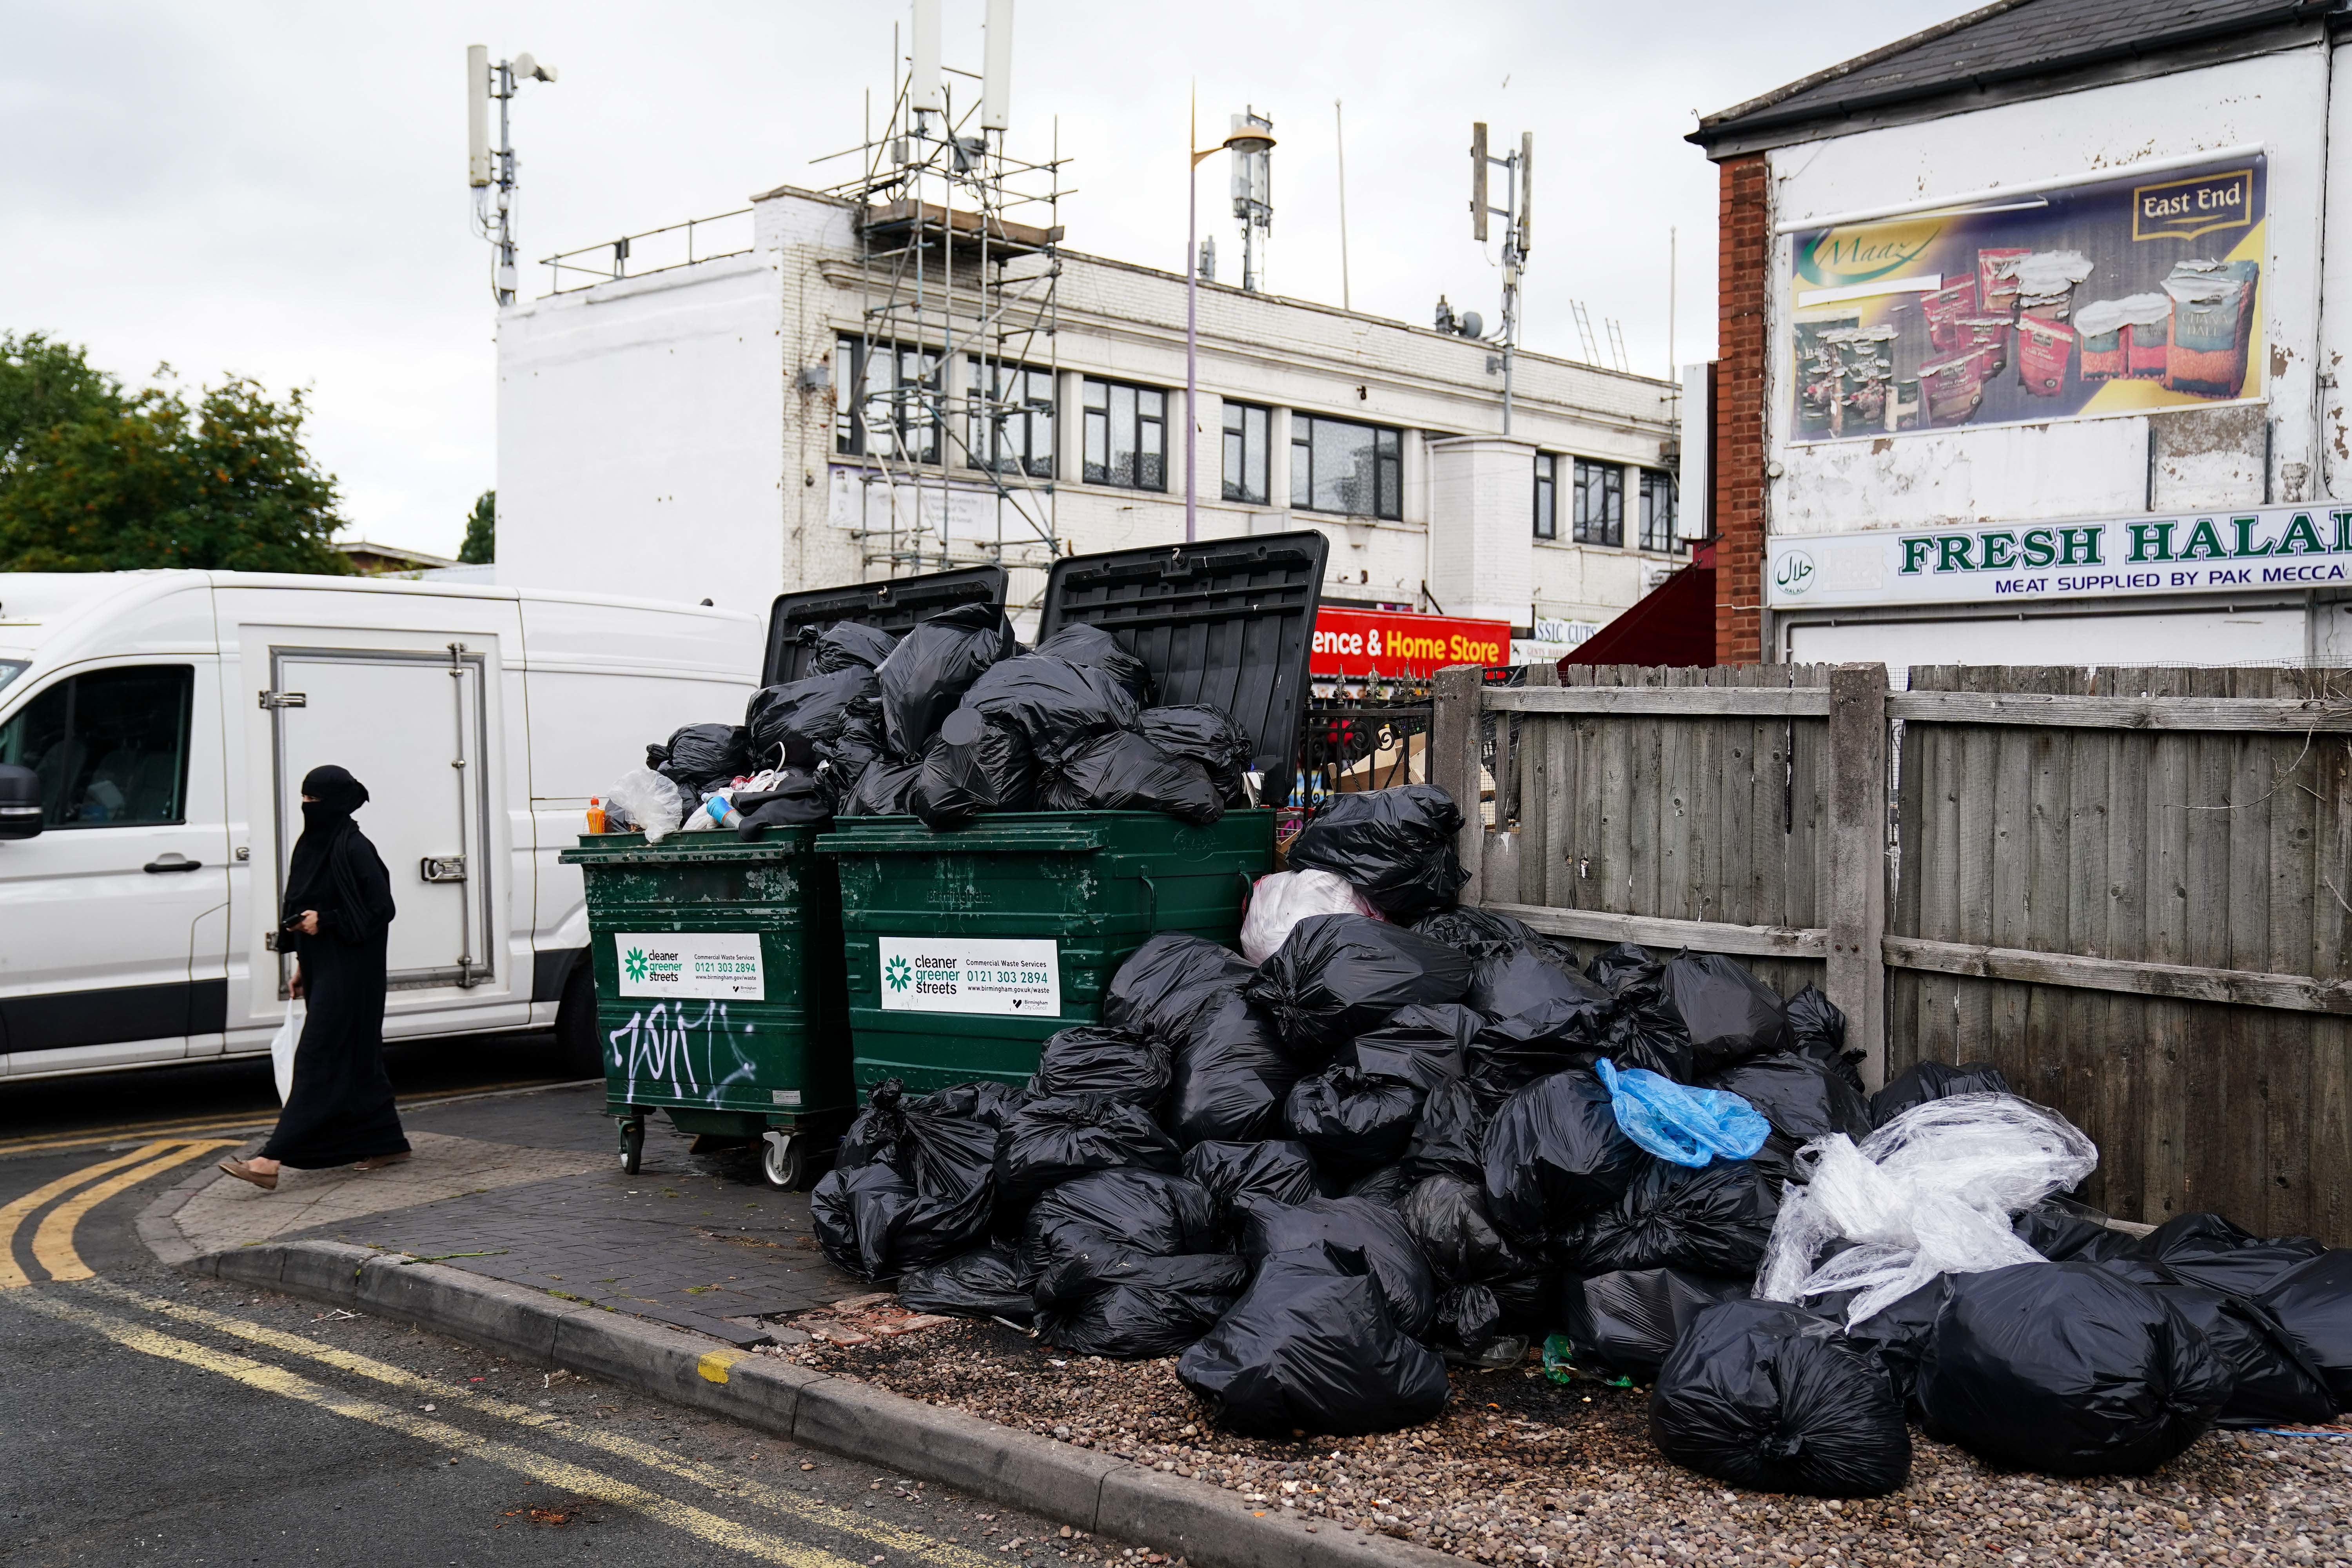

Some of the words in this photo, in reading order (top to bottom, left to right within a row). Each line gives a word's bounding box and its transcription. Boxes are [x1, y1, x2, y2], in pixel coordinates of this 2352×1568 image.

[2143, 192, 2190, 218] East
[2197, 182, 2241, 210] End
[1816, 235, 1927, 268] Maaz
[2182, 312, 2228, 325] CHANA
[1899, 524, 2105, 575] FRESH
[1777, 556, 1813, 585] حلال
[1996, 578, 2048, 593] MEAT
[2058, 573, 2160, 591] SUPPLIED
[2171, 571, 2199, 586] BY
[2209, 568, 2252, 584] PAK
[2263, 564, 2345, 582] MECCA
[1367, 629, 1382, 656] &
[1387, 630, 1446, 660] Home
[1450, 634, 1499, 662] Store
[649, 949, 679, 961] cleaner
[915, 955, 957, 969] cleaner
[649, 962, 683, 975] greener
[695, 962, 715, 973] 0121
[718, 963, 733, 973] 303
[735, 963, 756, 973] 2894
[649, 972, 679, 982] streets
[916, 970, 960, 984] greener
[967, 971, 992, 982] 0121
[997, 971, 1016, 983] 303
[1020, 972, 1048, 984] 2894
[916, 981, 957, 995] streets
[967, 985, 1050, 994] www.birmingham.gov.uk/waste
